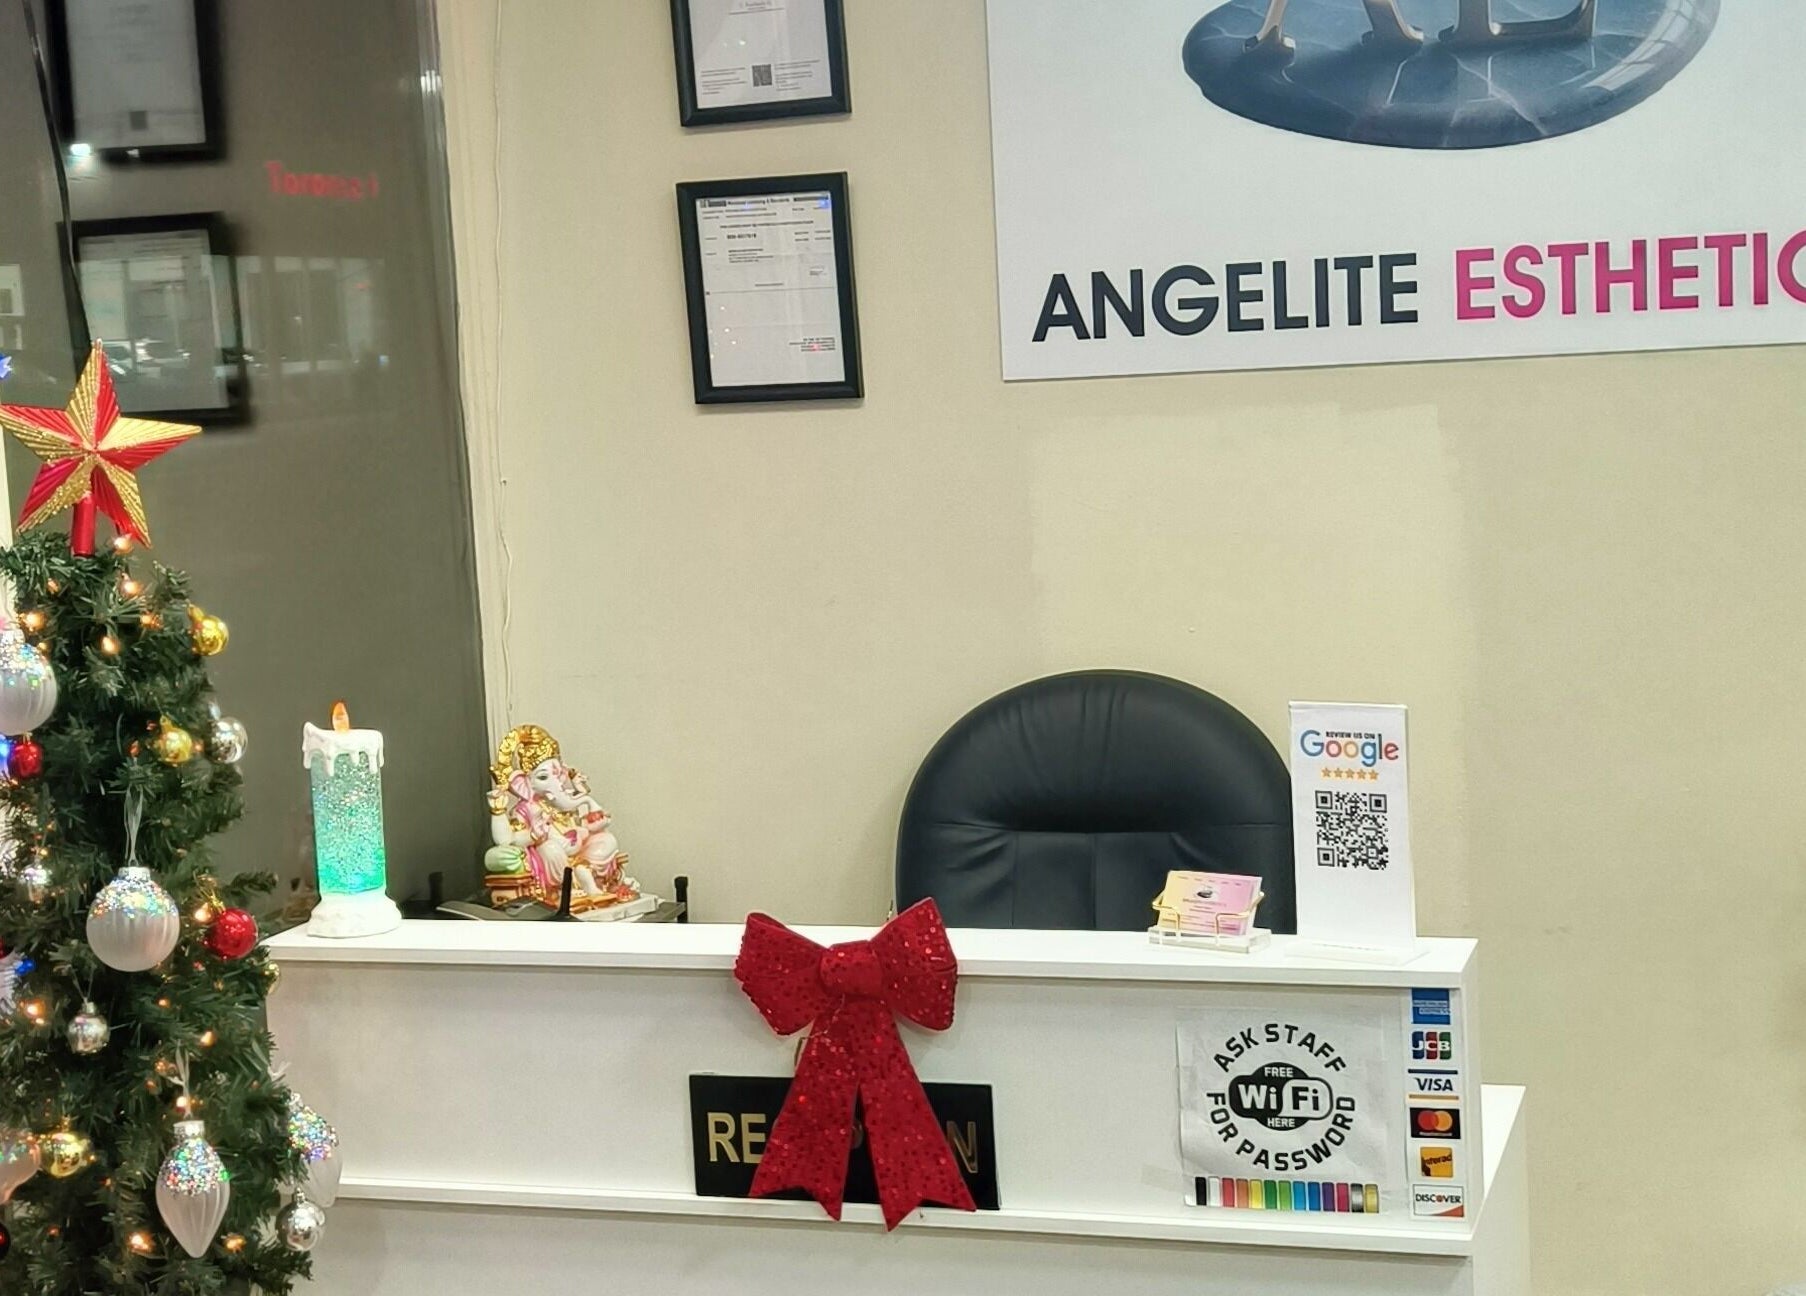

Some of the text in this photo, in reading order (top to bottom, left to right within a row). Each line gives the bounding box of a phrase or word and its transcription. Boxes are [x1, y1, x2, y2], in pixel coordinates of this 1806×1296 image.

[1031, 252, 1419, 342] ANGELITE
[1300, 729, 1399, 767] Google
[1214, 1023, 1346, 1072] ASK STAFF
[1264, 1067, 1294, 1077] FREE
[1415, 1077, 1454, 1091] VISA
[1206, 1092, 1356, 1171] FOR PASSWORD
[1267, 1117, 1296, 1128] HERE
[1415, 1193, 1462, 1204] DISCOVER
